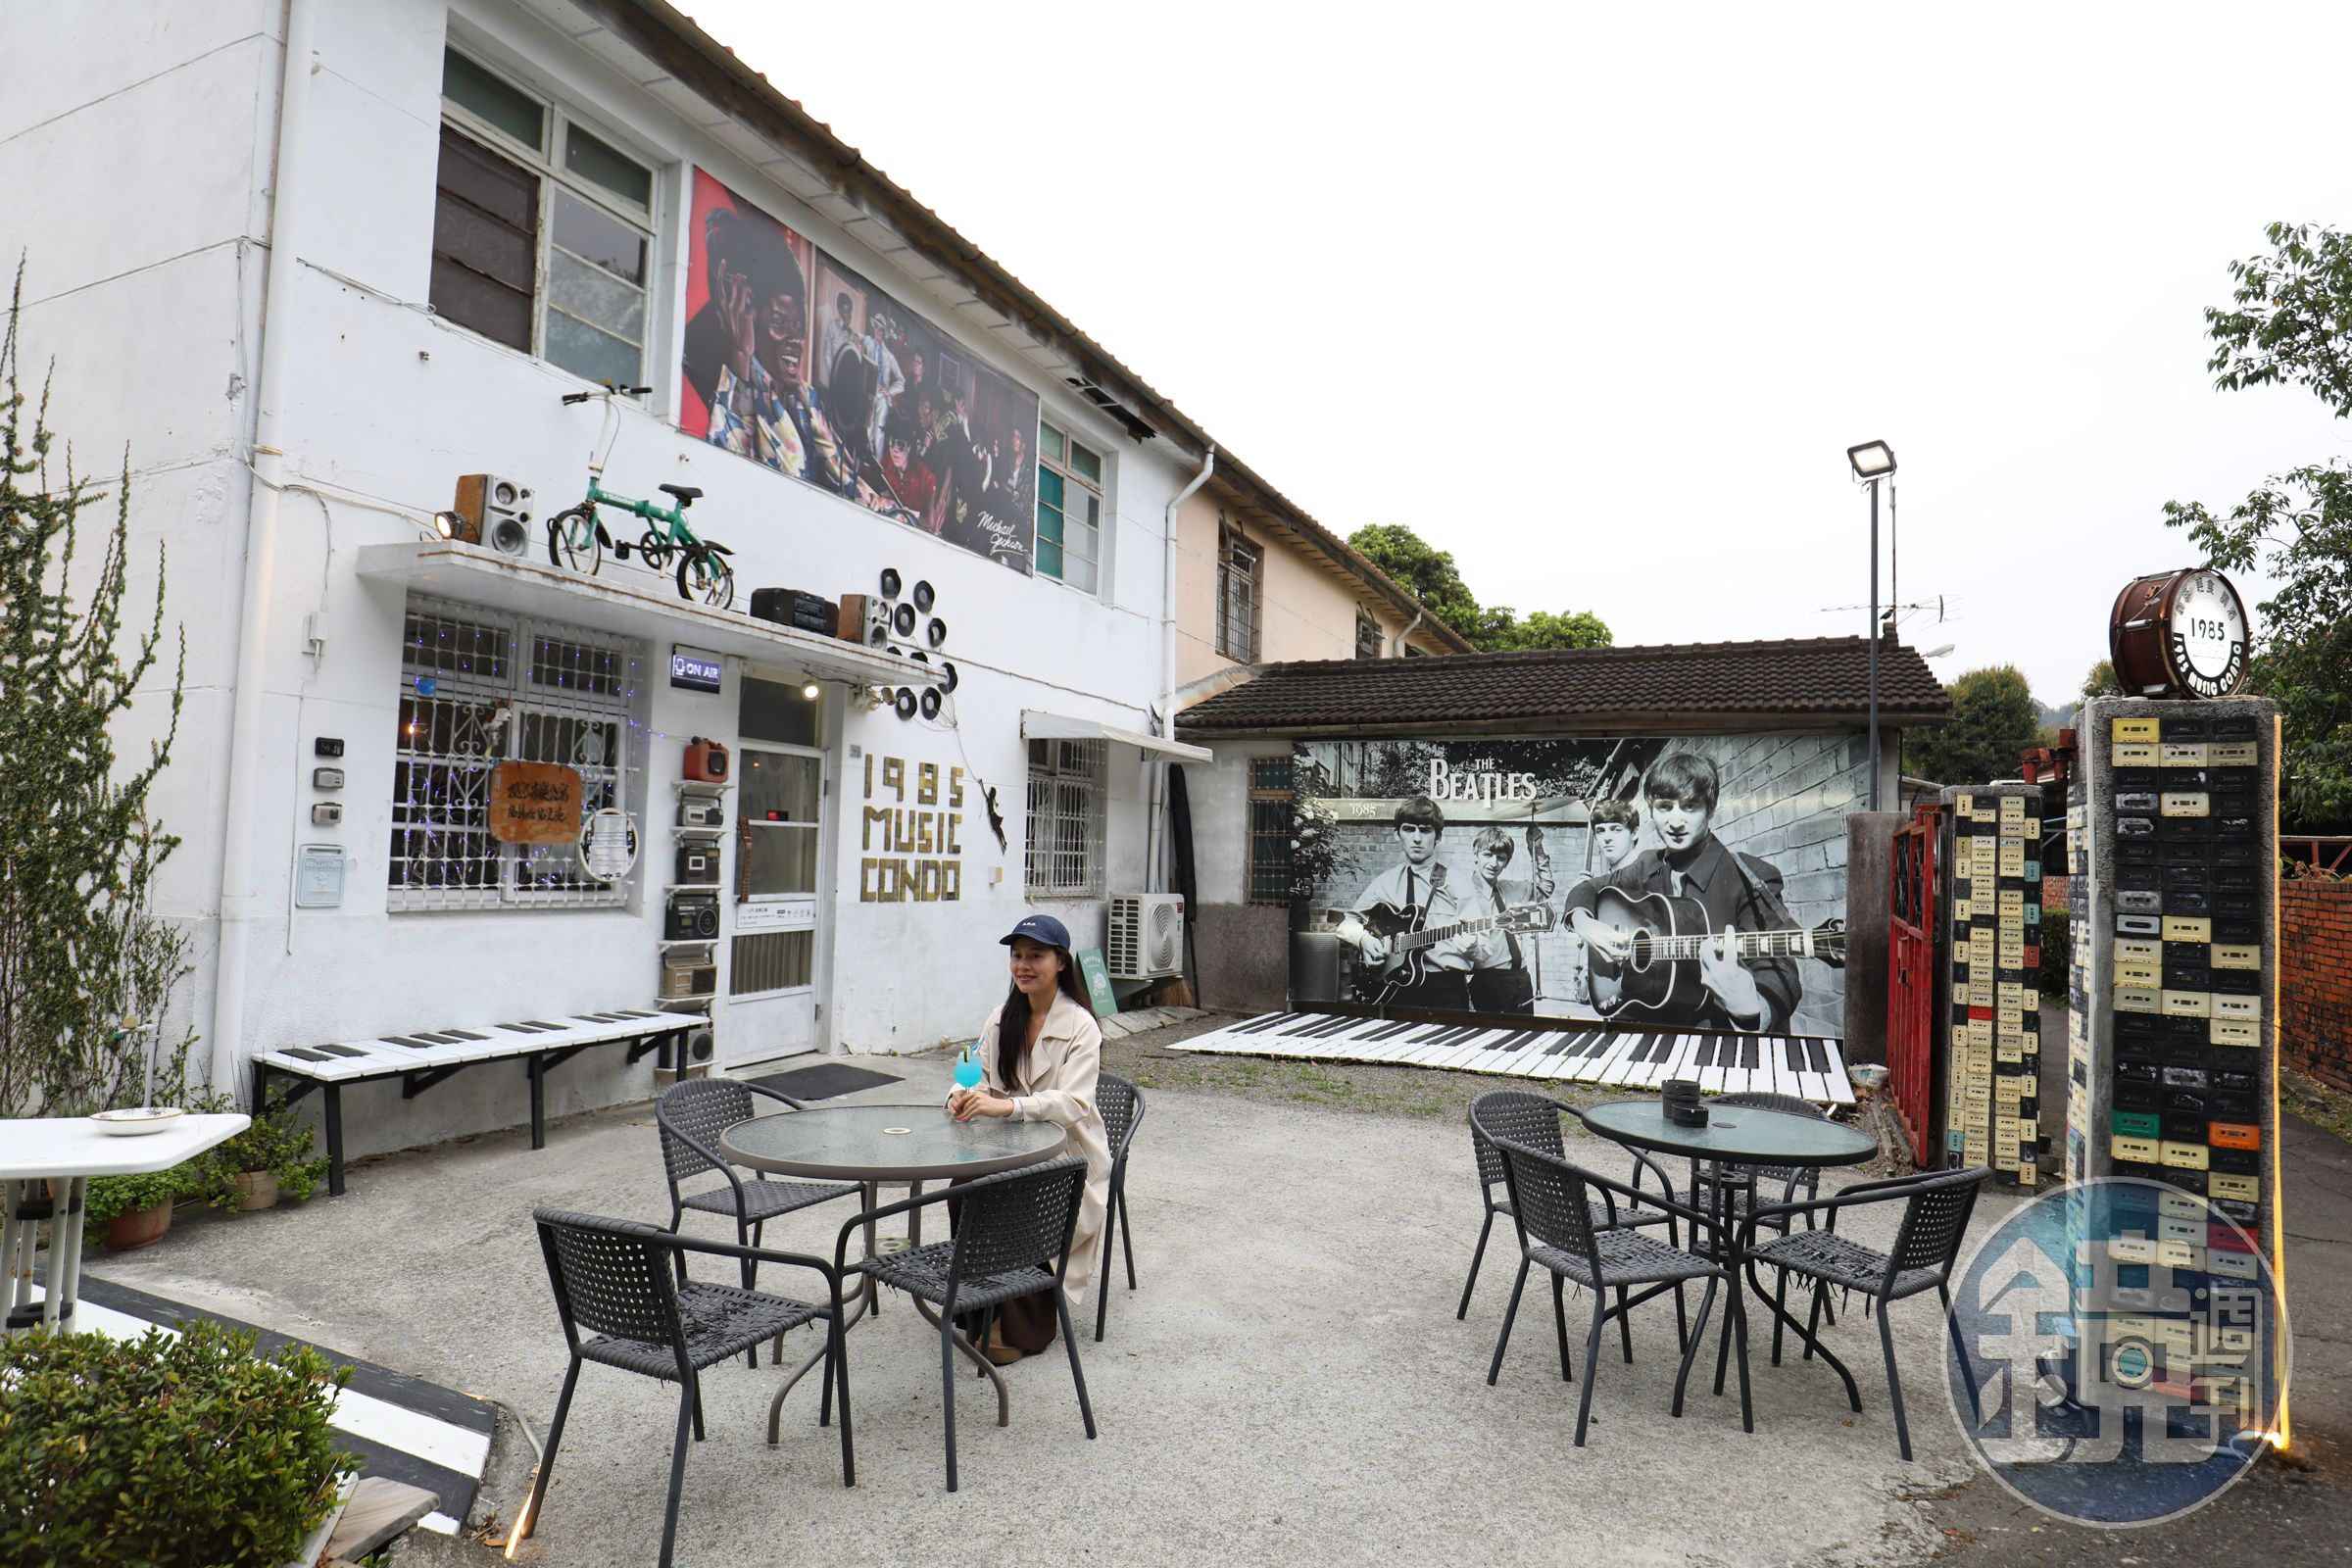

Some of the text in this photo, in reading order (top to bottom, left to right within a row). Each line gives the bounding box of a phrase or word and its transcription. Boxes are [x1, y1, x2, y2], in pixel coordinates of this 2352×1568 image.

[977, 511, 1017, 537] Michael
[989, 533, 1028, 556] Jackson
[2191, 617, 2225, 641] 1985
[687, 662, 718, 678] ON AIR
[2173, 636, 2189, 673] 1985
[2187, 671, 2218, 696] MUSIC
[2220, 644, 2242, 692] CONDO
[1475, 758, 1494, 770] THE
[863, 753, 964, 808] 1985
[1430, 758, 1537, 808] BEATLES
[1352, 803, 1376, 818] 1985
[862, 806, 962, 855] MUSIC
[860, 858, 960, 903] CONDO
